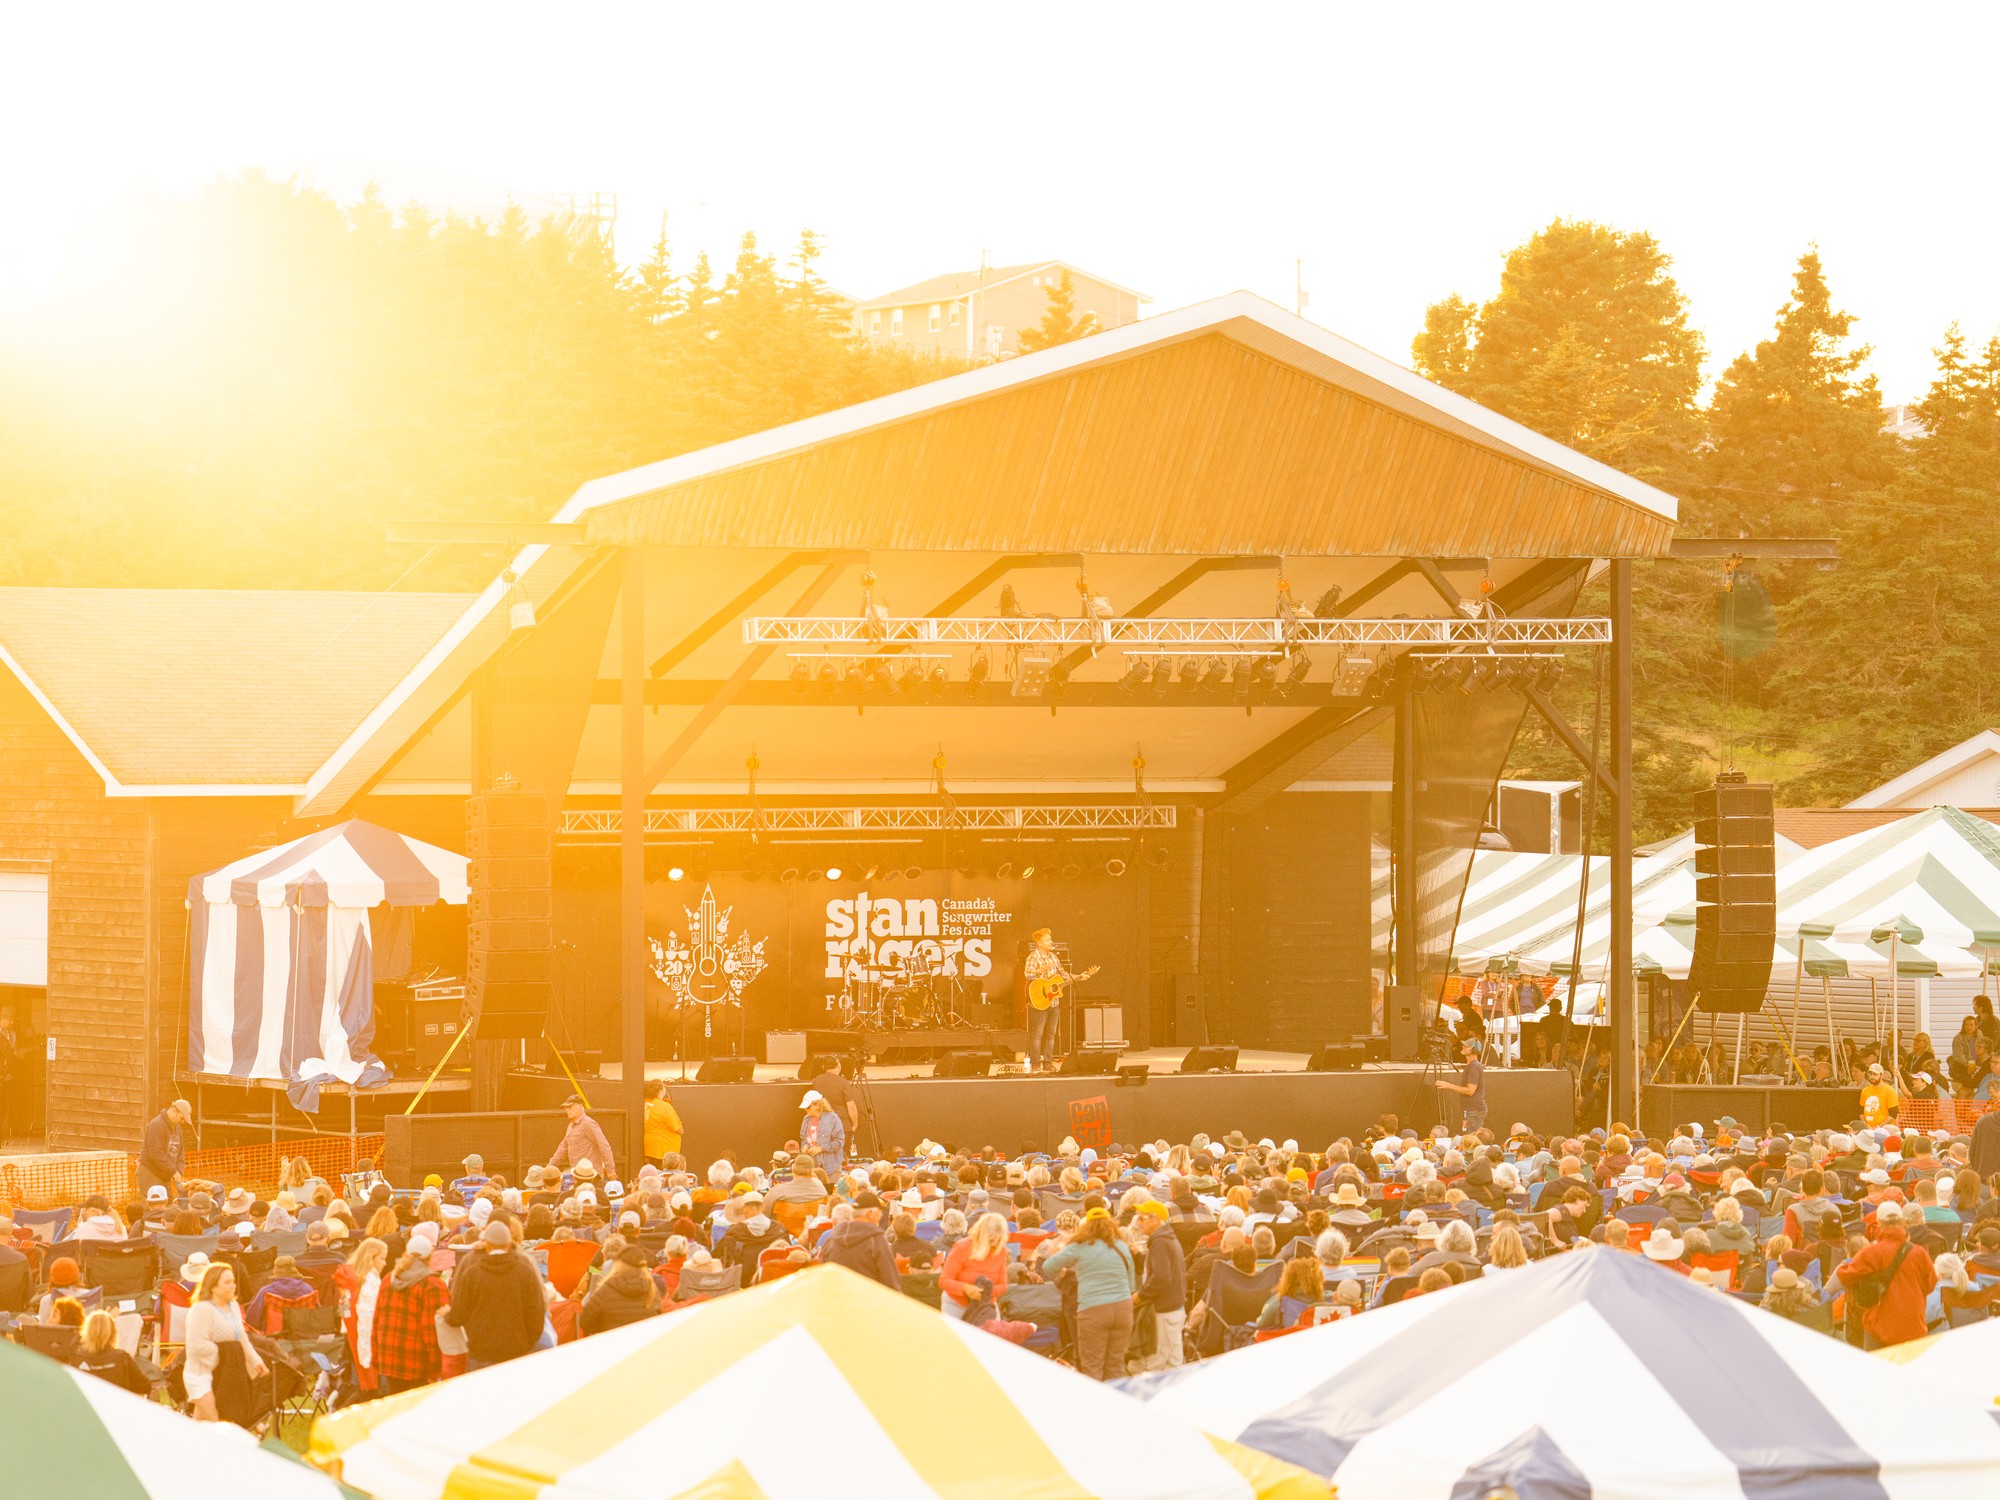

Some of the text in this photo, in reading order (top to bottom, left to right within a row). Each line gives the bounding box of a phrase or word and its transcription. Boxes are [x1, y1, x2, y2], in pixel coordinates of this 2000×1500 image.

[942, 897, 995, 910] Canada's
[825, 891, 940, 938] stan
[942, 910, 1012, 926] Songwriter
[942, 923, 992, 936] Festival
[664, 960, 683, 975] 20
[1072, 1101, 1106, 1124] Can
[1075, 1121, 1107, 1147] So!
